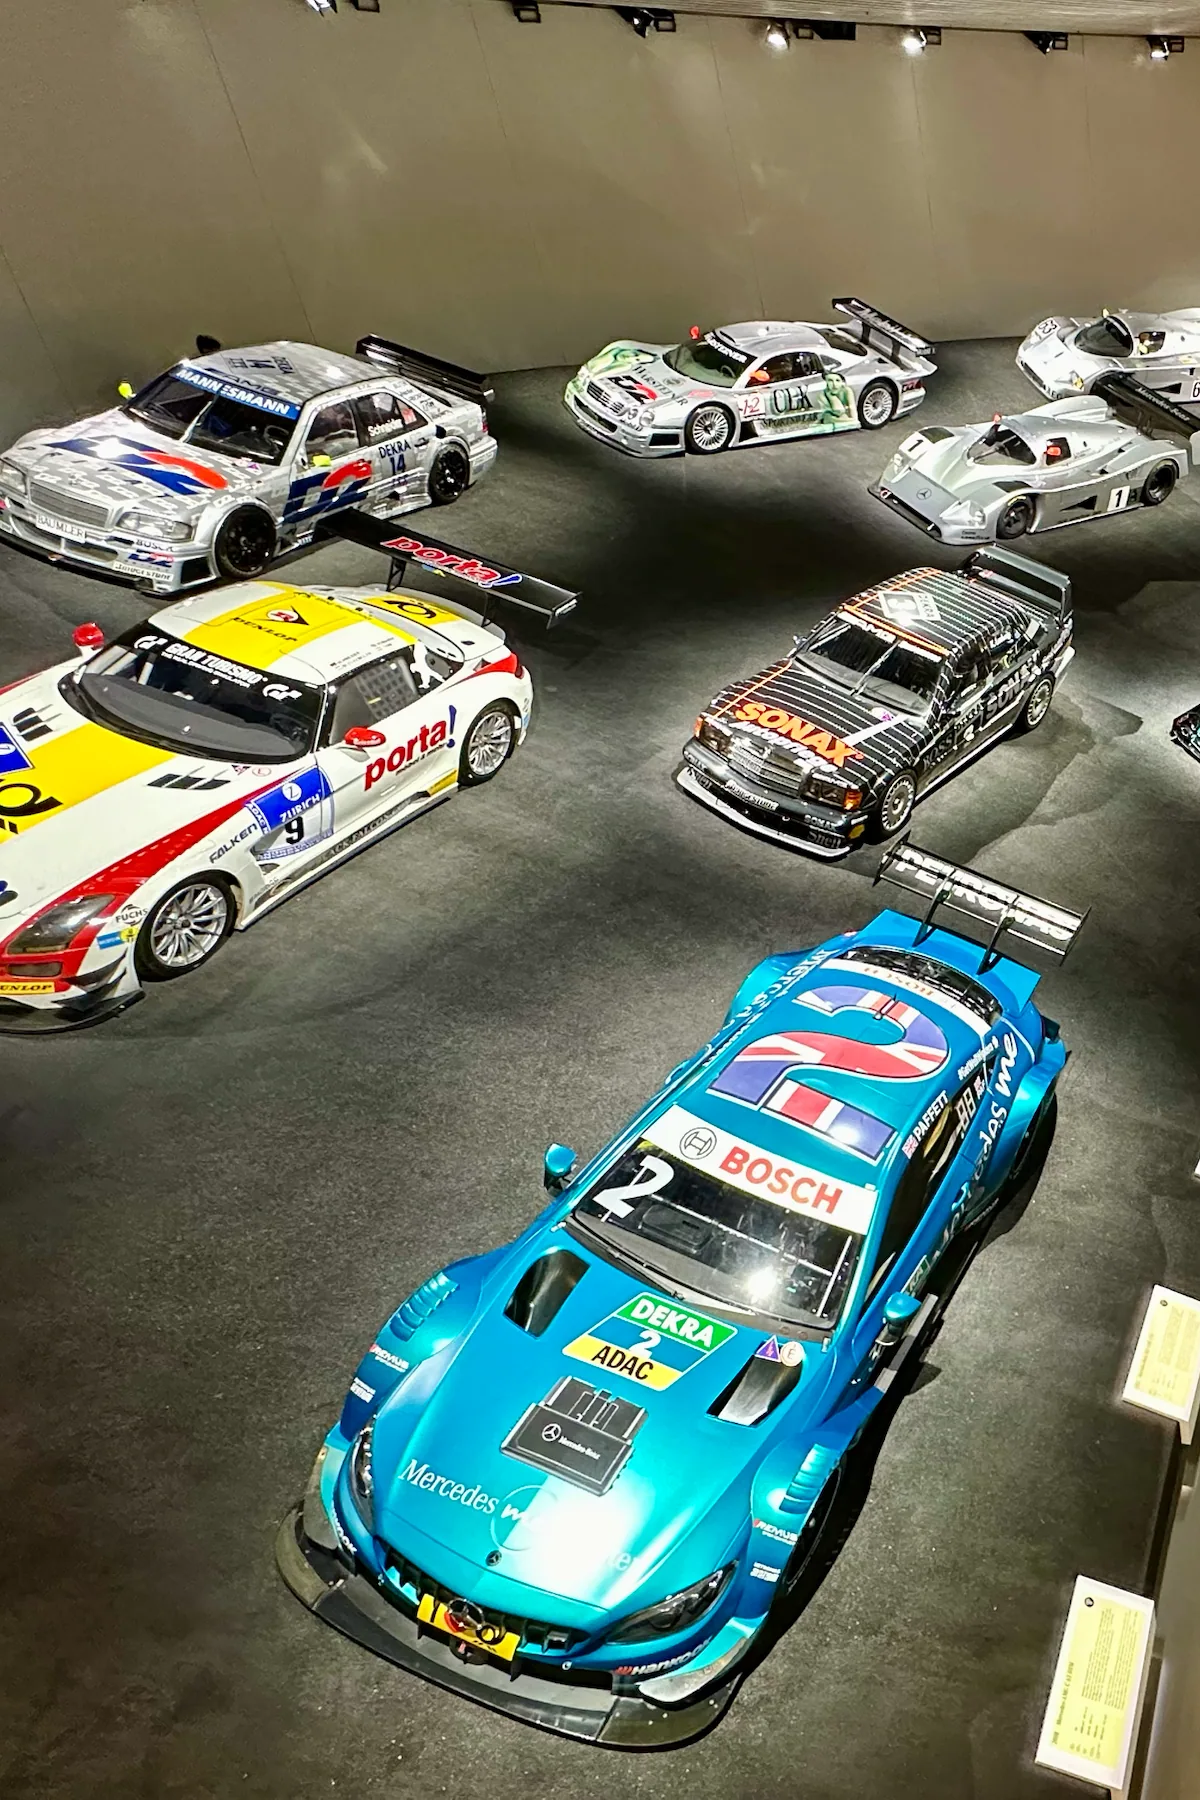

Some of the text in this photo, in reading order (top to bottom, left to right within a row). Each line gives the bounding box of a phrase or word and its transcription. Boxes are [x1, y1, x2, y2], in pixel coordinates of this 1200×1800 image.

[176, 369, 290, 415] MANNESMANN
[378, 439, 411, 459] DEKRA
[389, 453, 405, 476] 14
[908, 439, 924, 452] 1
[1114, 490, 1124, 508] 1
[380, 536, 523, 588] porta!
[233, 617, 297, 642] DUNLOP
[364, 704, 457, 791] porta!
[736, 703, 858, 768] SONAX
[284, 815, 304, 845] 9
[116, 908, 148, 923] FUCHS
[0, 983, 53, 992] UNLOP
[706, 984, 951, 1167] 2
[914, 1090, 949, 1142] PAFFETT
[592, 1155, 675, 1219] 2
[719, 1146, 843, 1215] BOSCH
[629, 1329, 662, 1358] 2
[631, 1298, 714, 1349] DEKRA
[592, 1345, 654, 1381] ADAC
[398, 1458, 500, 1515] Mercedes
